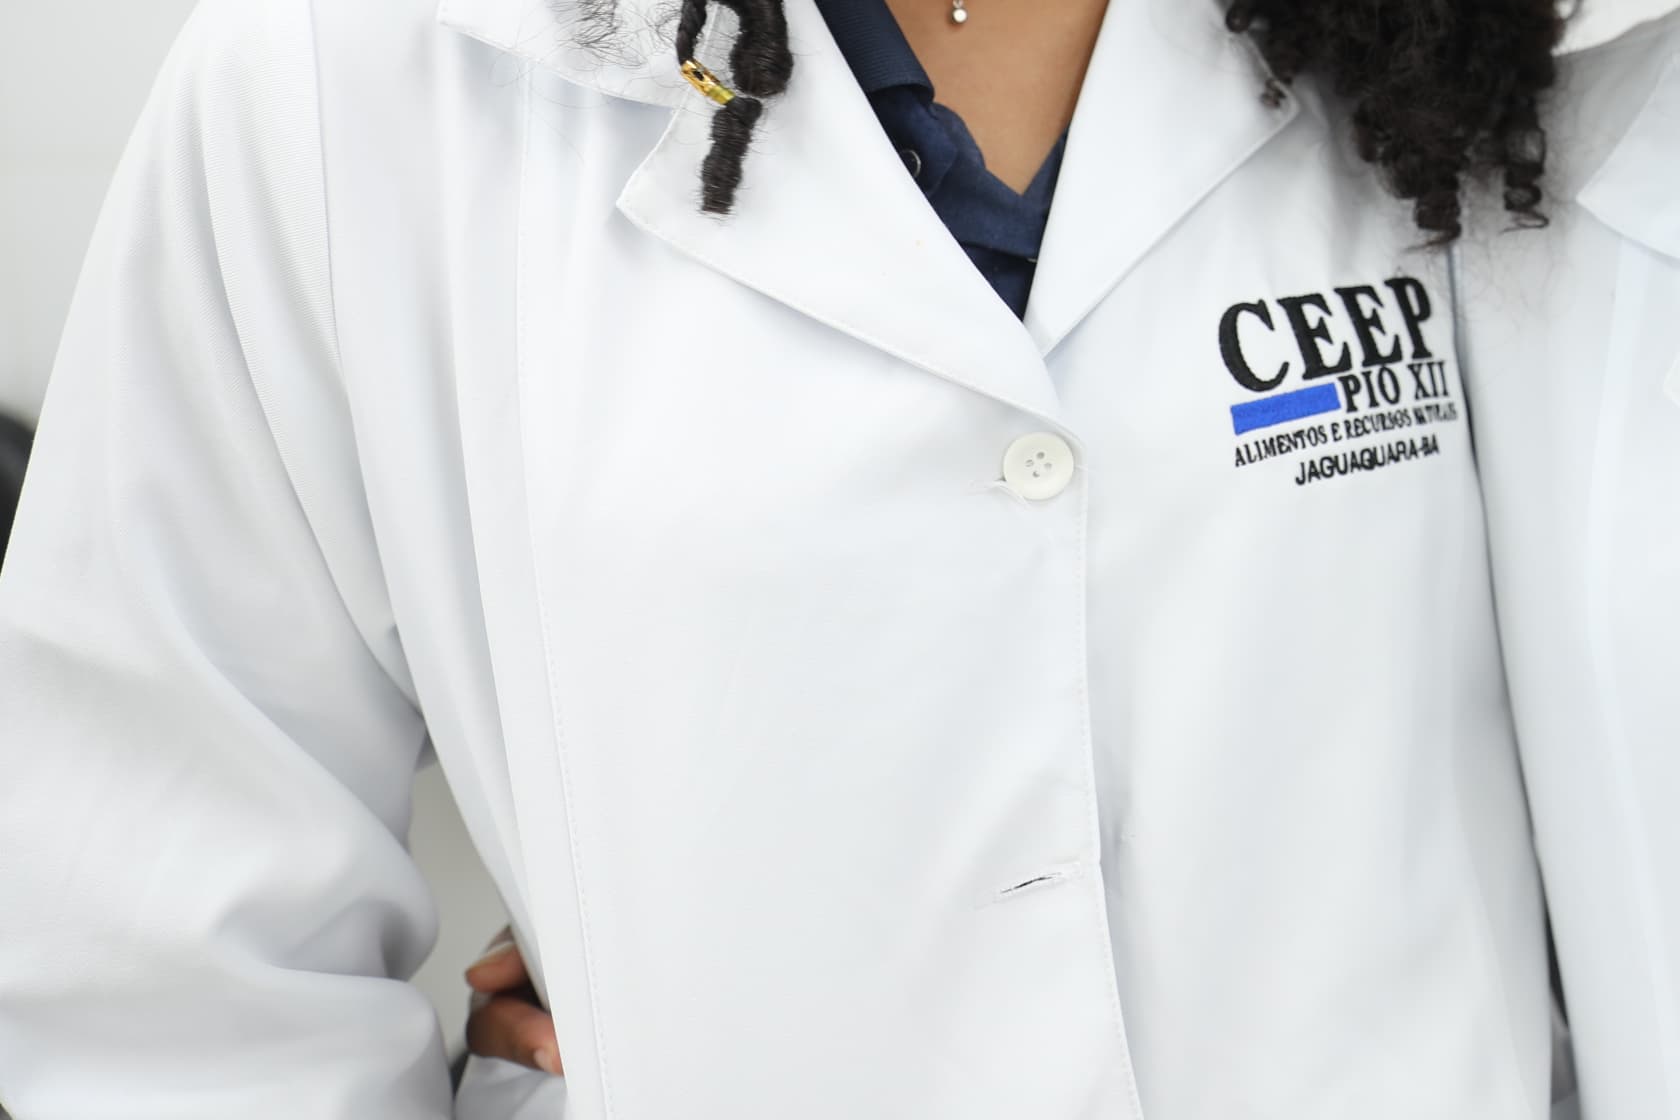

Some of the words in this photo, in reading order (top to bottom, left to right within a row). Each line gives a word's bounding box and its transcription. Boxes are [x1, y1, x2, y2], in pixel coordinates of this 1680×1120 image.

[1218, 276, 1432, 392] CEEP
[1337, 363, 1401, 414] PIO
[1407, 360, 1449, 400] XII
[1234, 425, 1328, 468] ALIMENTOS
[1332, 422, 1344, 442] E
[1344, 407, 1412, 440] RECURSOS
